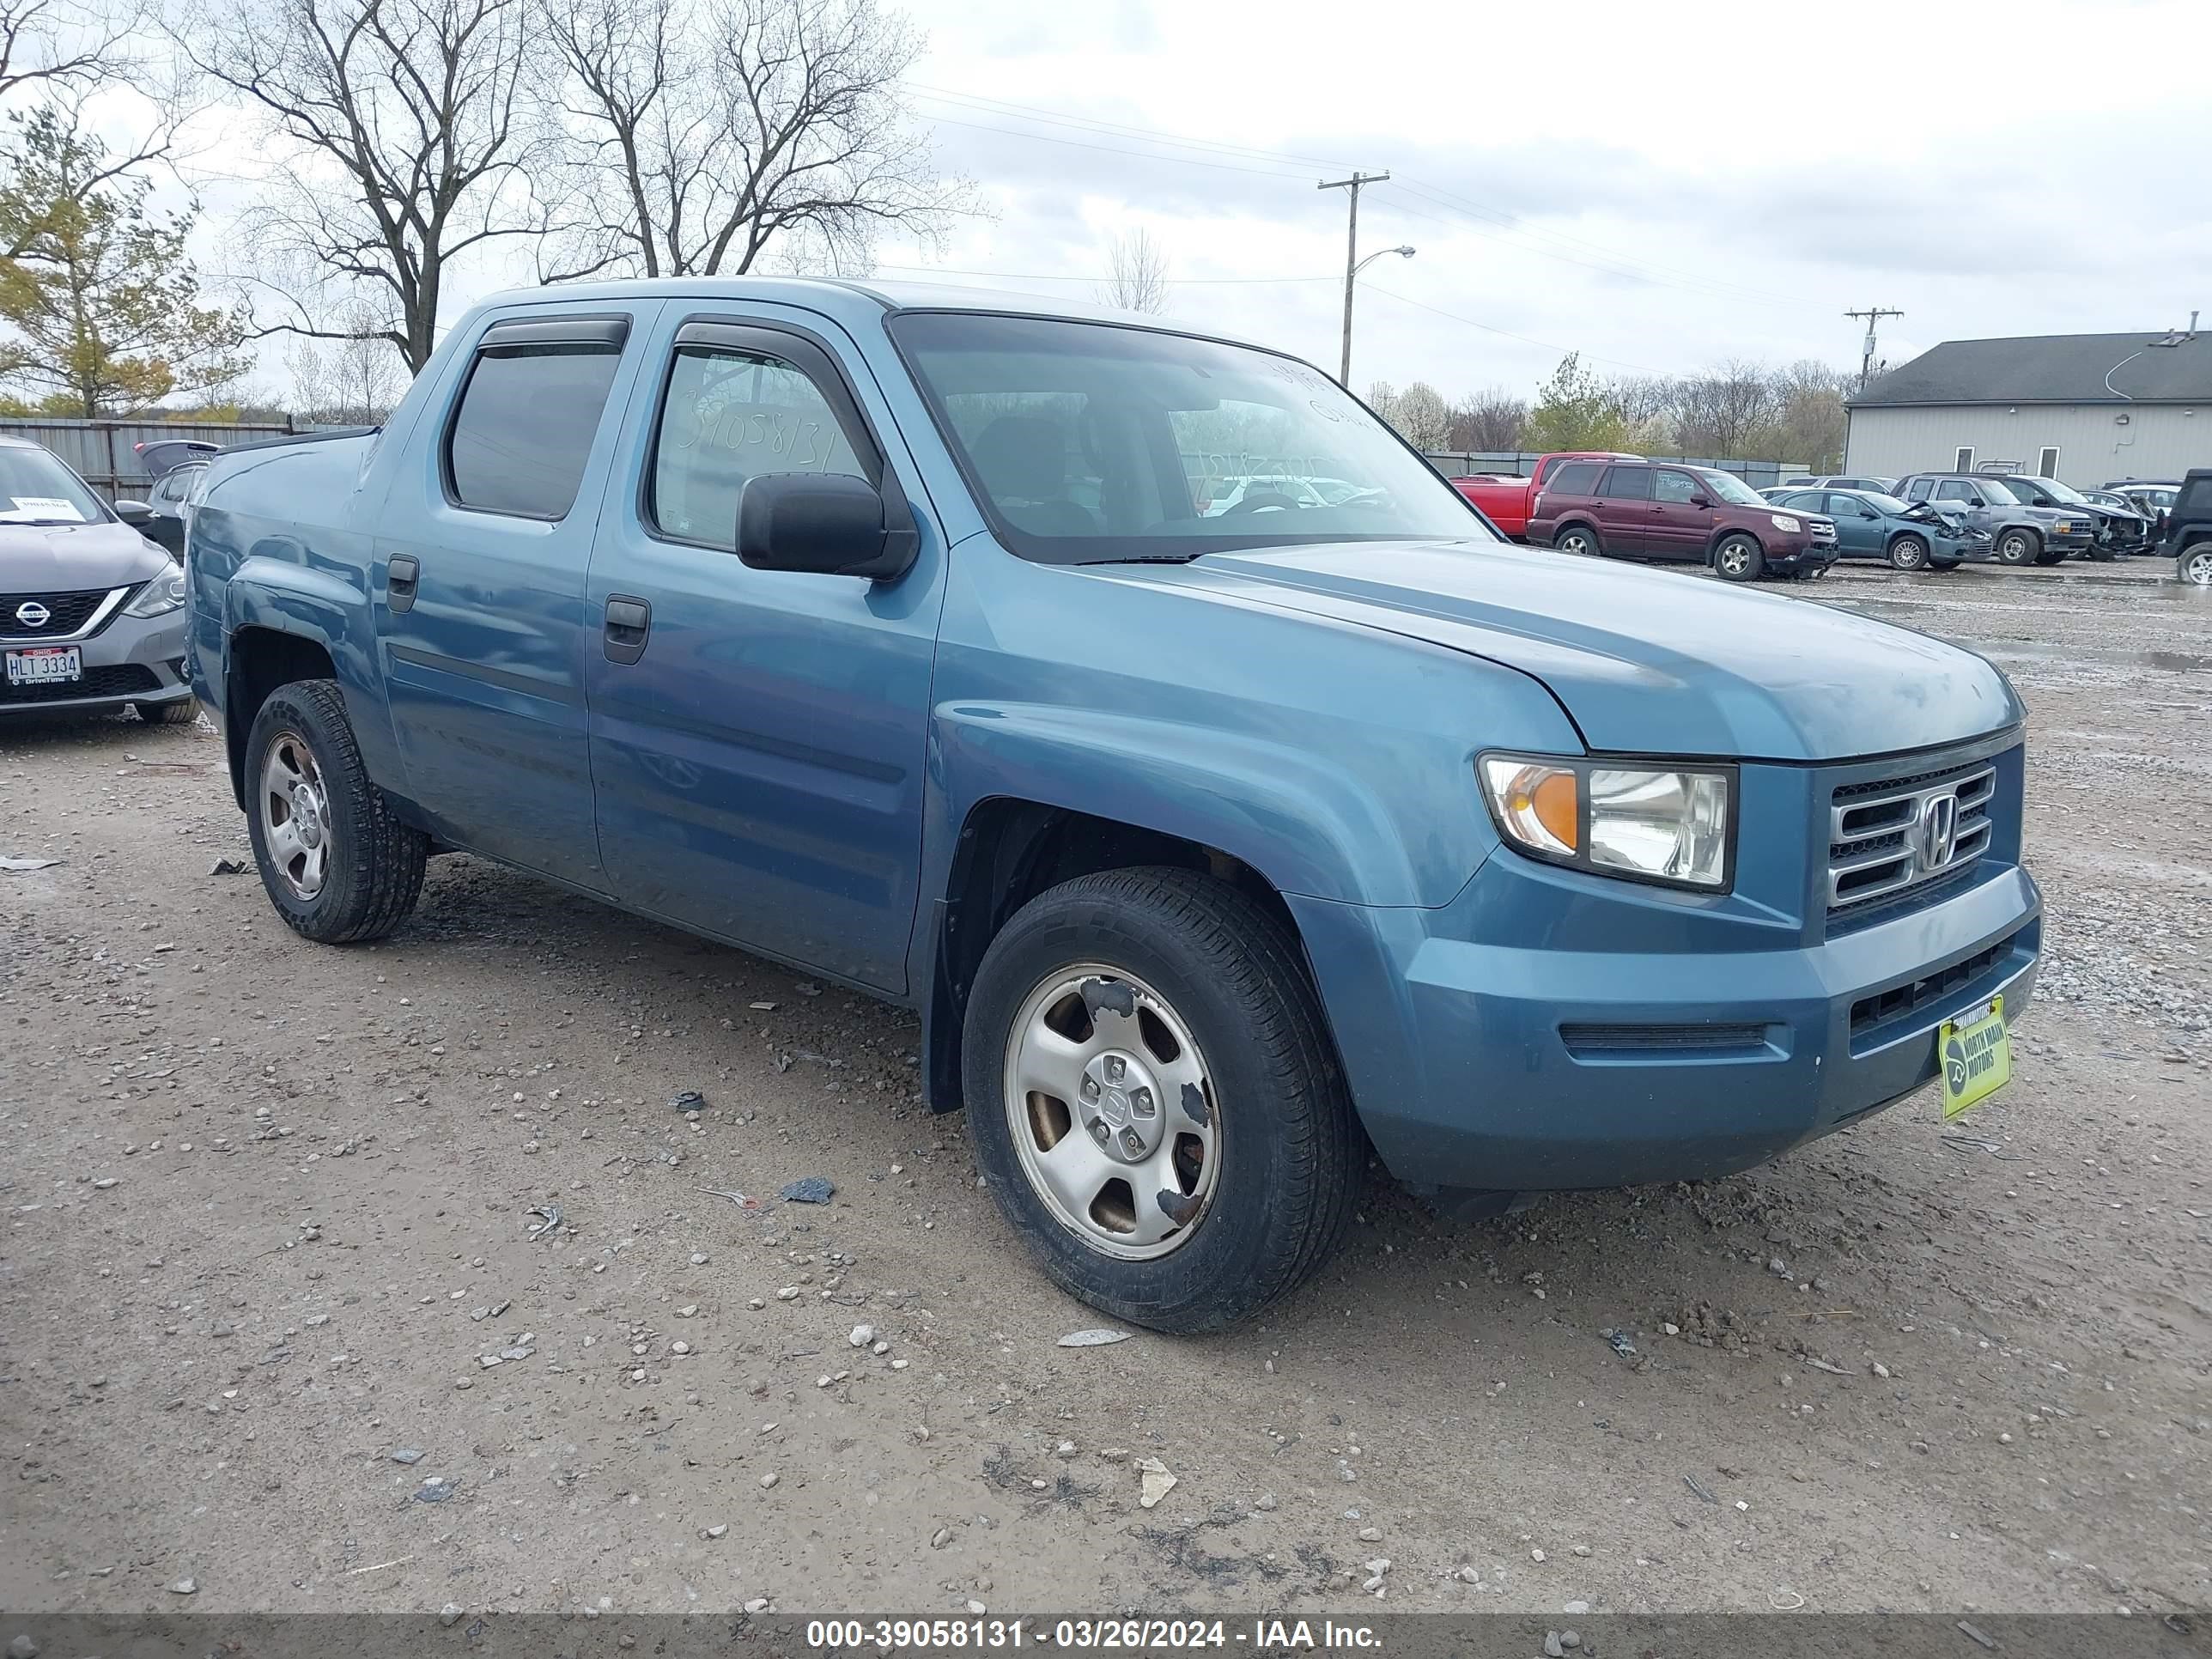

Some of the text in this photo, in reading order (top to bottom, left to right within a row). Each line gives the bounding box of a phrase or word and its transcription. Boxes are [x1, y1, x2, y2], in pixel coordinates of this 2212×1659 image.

[678, 391, 836, 474] 39058131
[10, 655, 76, 676] HLT 3334
[25, 677, 66, 685] DriveTime
[1964, 1022, 2005, 1058] NORTH MAIN
[1967, 1048, 1995, 1079] MOTORS
